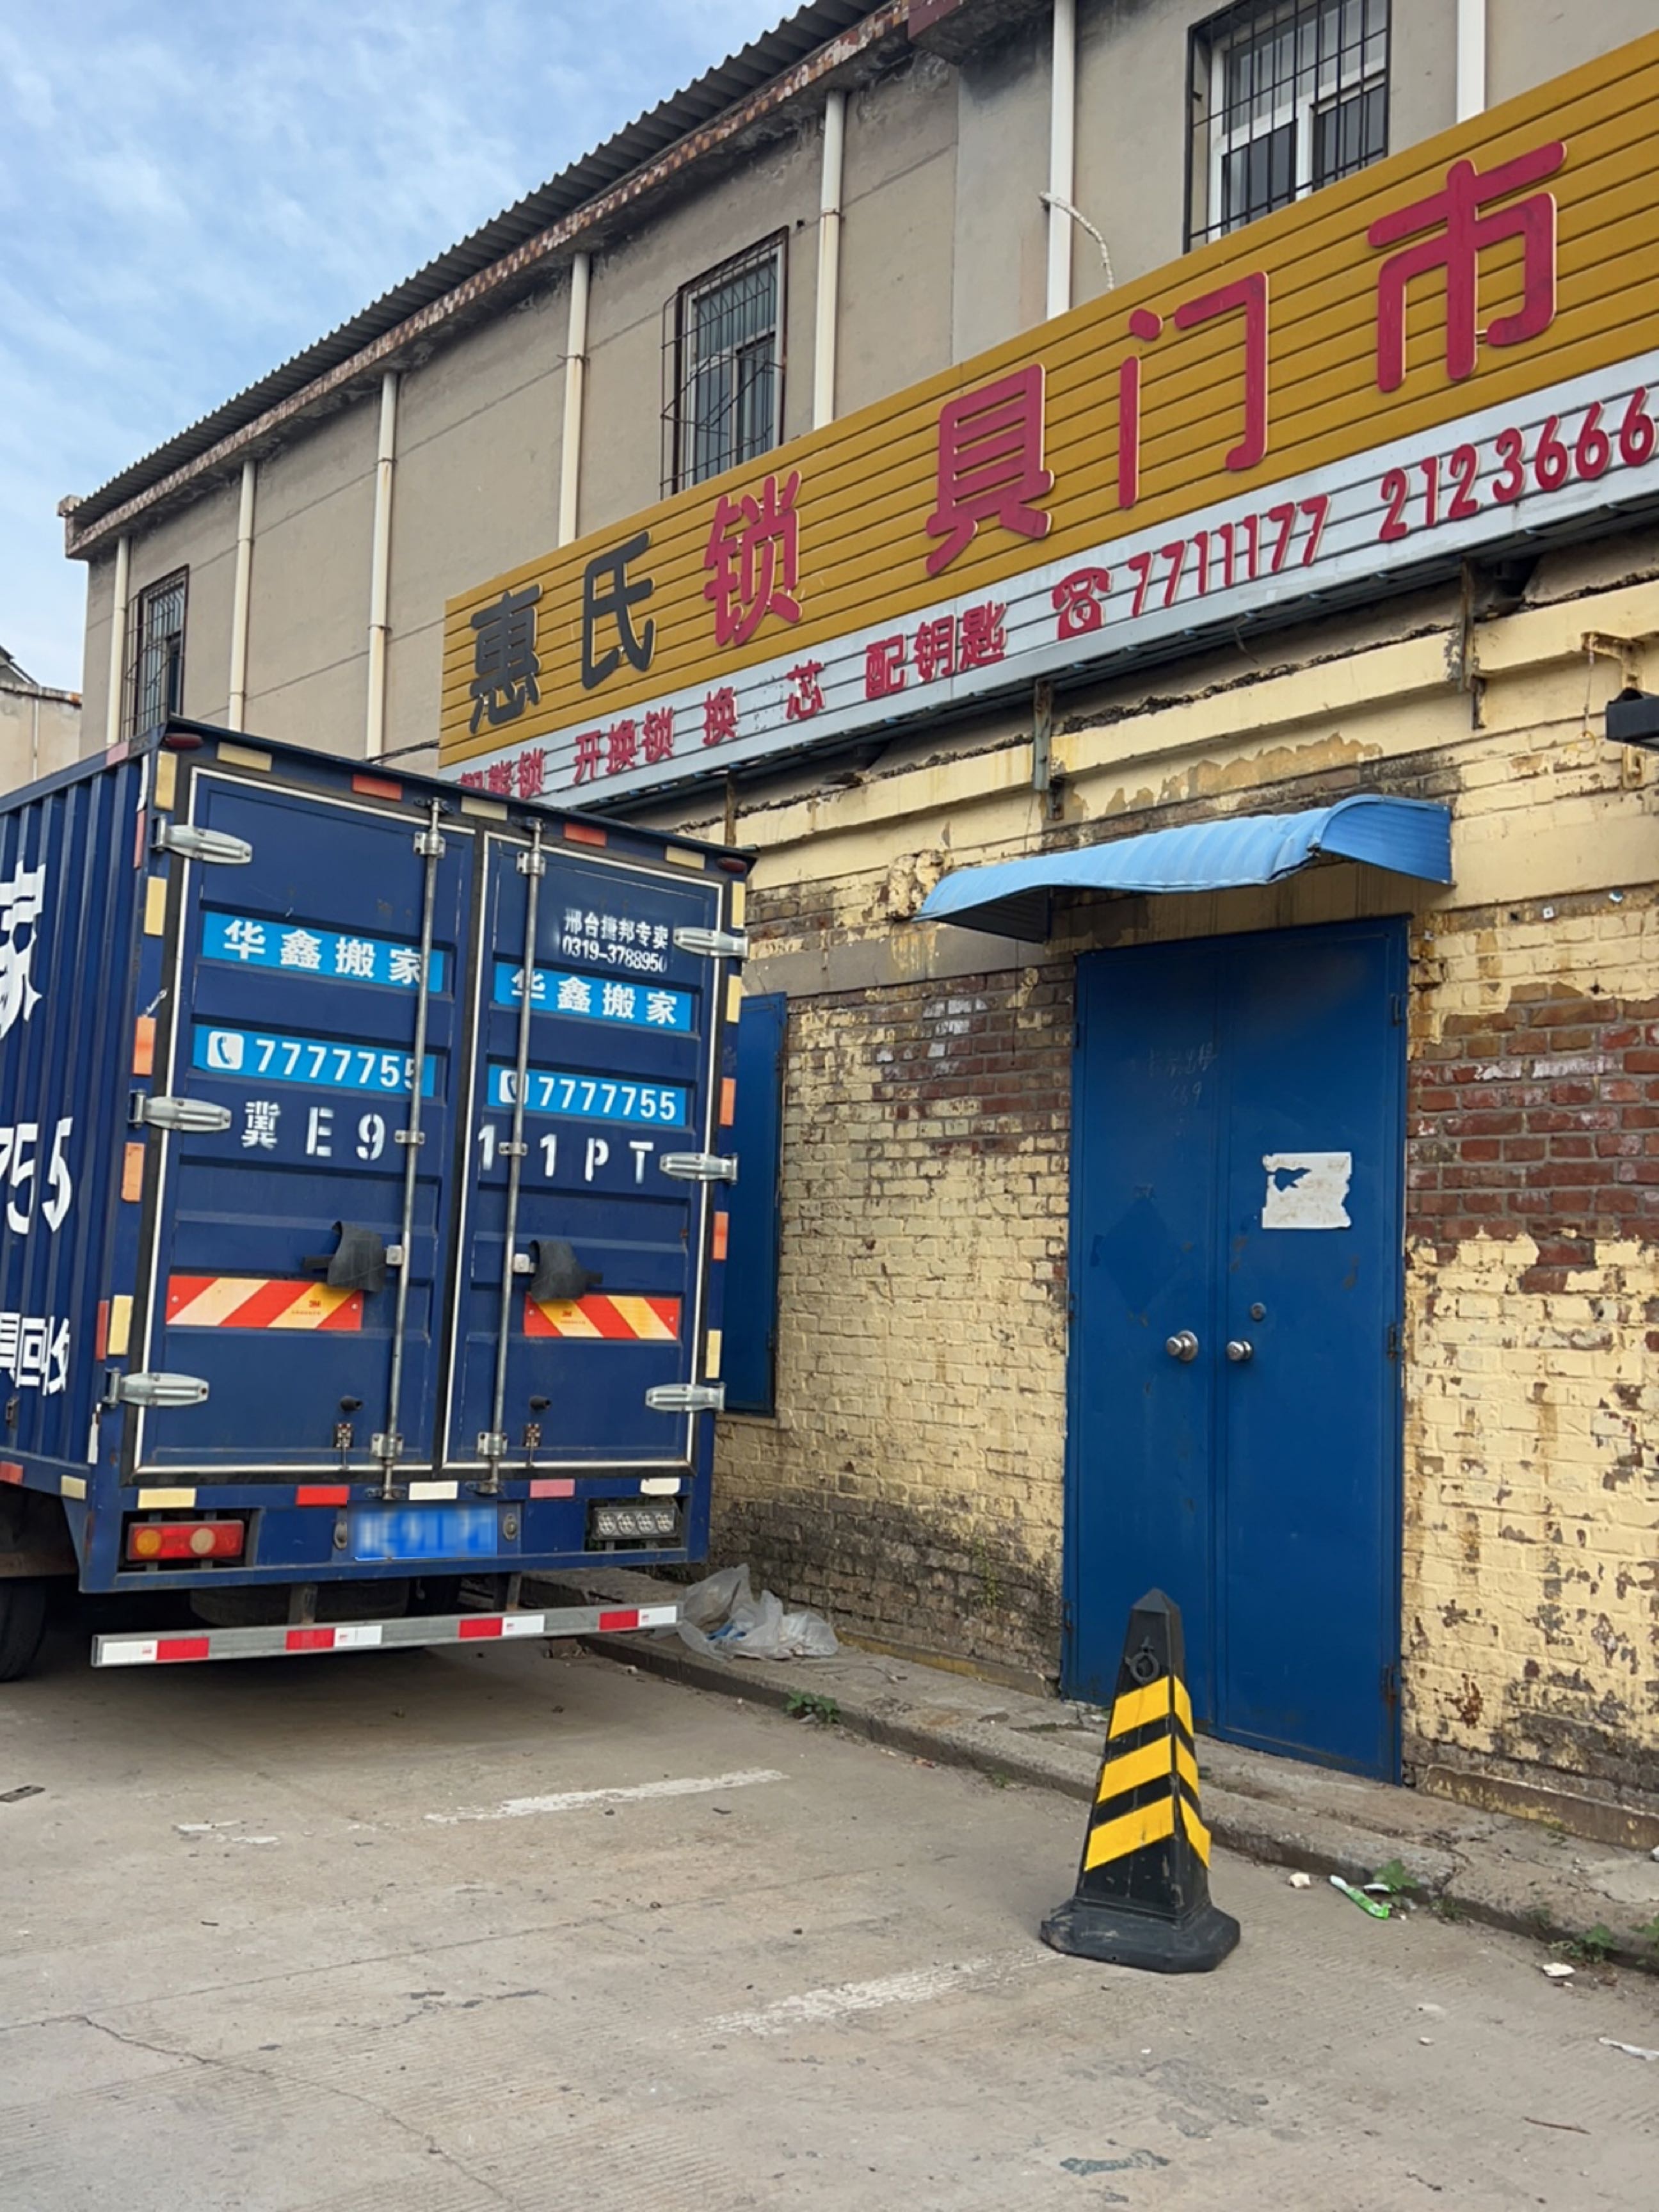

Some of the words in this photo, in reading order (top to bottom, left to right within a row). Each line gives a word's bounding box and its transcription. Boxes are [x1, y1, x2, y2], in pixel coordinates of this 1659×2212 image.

[573, 707, 673, 785] 开换锁
[865, 600, 1007, 700] 配钥匙
[1379, 386, 1656, 541] 2123666
[223, 920, 422, 985] 华鑫搬家
[511, 968, 677, 1025] 华鑫搬家
[538, 1076, 676, 1121] 7777755
